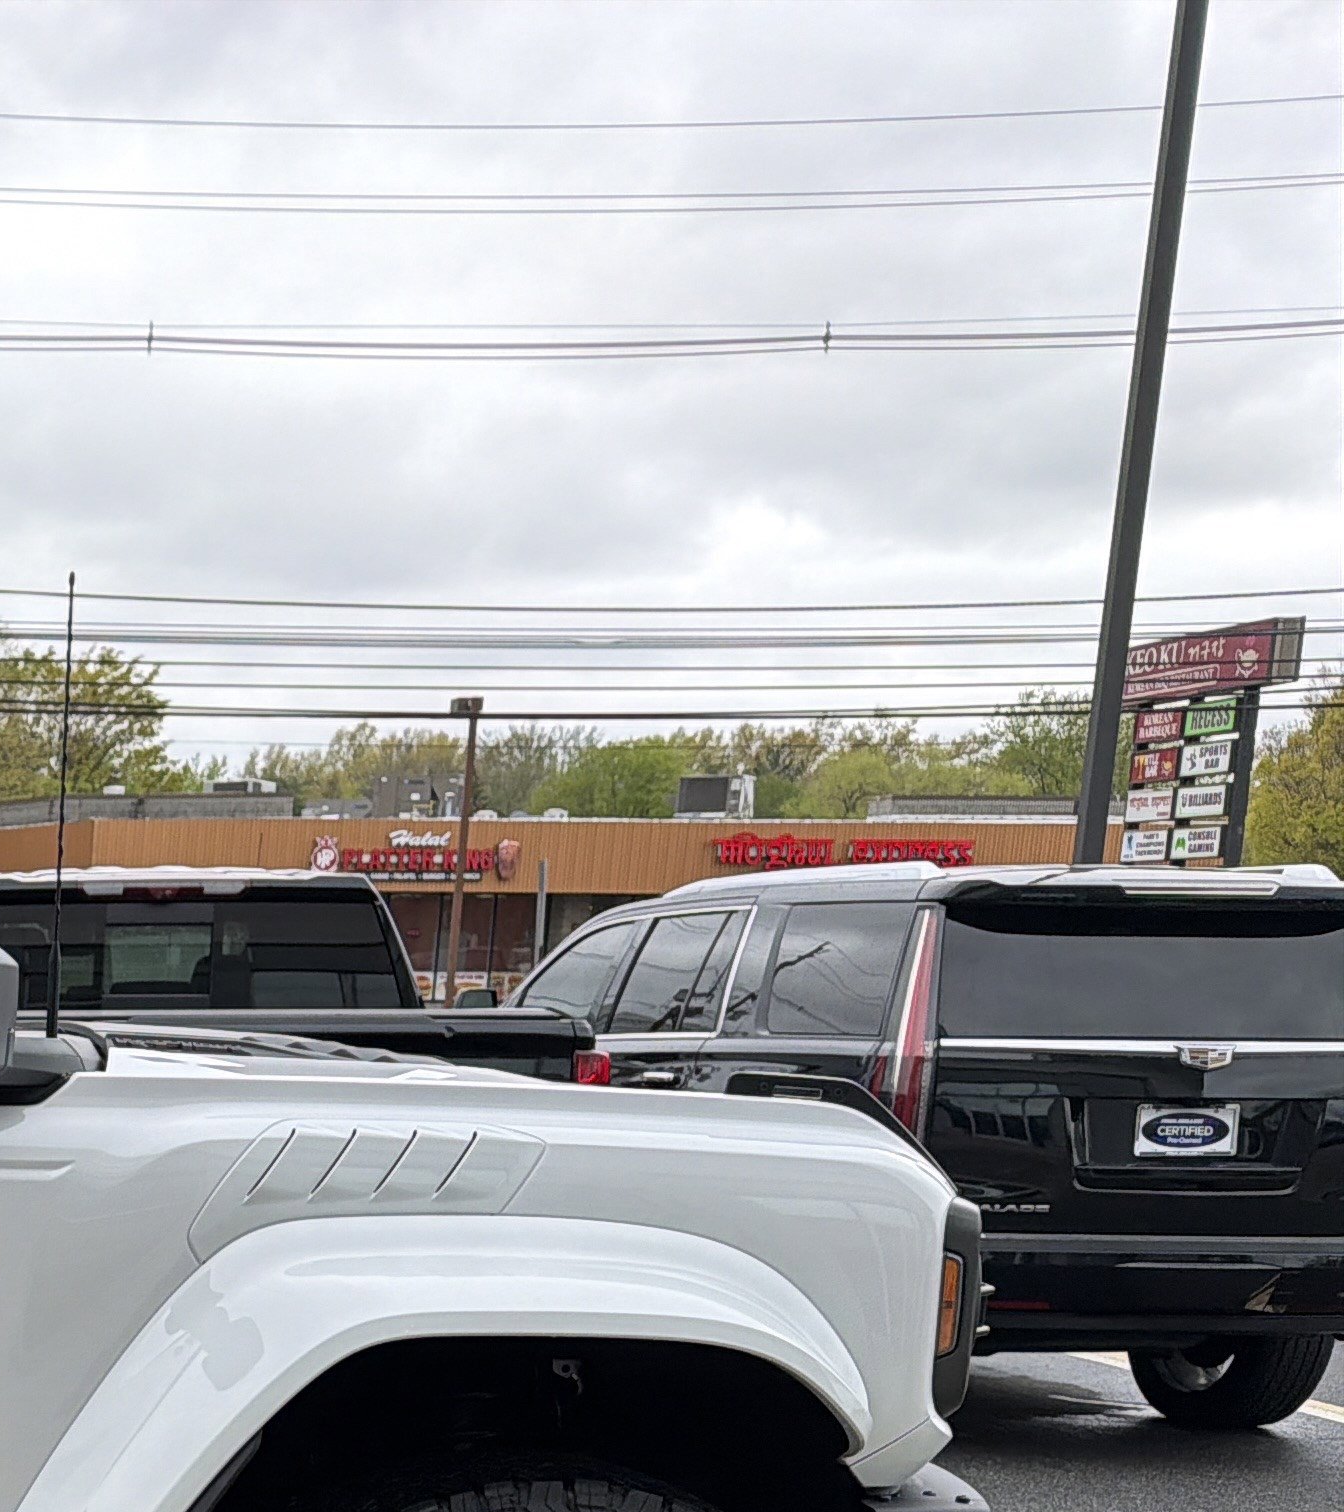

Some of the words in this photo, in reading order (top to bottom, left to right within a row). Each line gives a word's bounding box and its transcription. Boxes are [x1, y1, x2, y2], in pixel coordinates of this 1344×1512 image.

[1191, 704, 1231, 730] RECESS
[1199, 743, 1228, 758] SPORTS
[1204, 758, 1220, 770] BAR
[1188, 791, 1223, 807] BILLIARDS
[389, 829, 452, 847] Halal
[1188, 842, 1214, 854] GAMING
[342, 847, 436, 872] PLATTER
[443, 848, 495, 872] KNG
[1157, 1125, 1214, 1137] CERTIFIED
[981, 1203, 1051, 1213] ALADE
